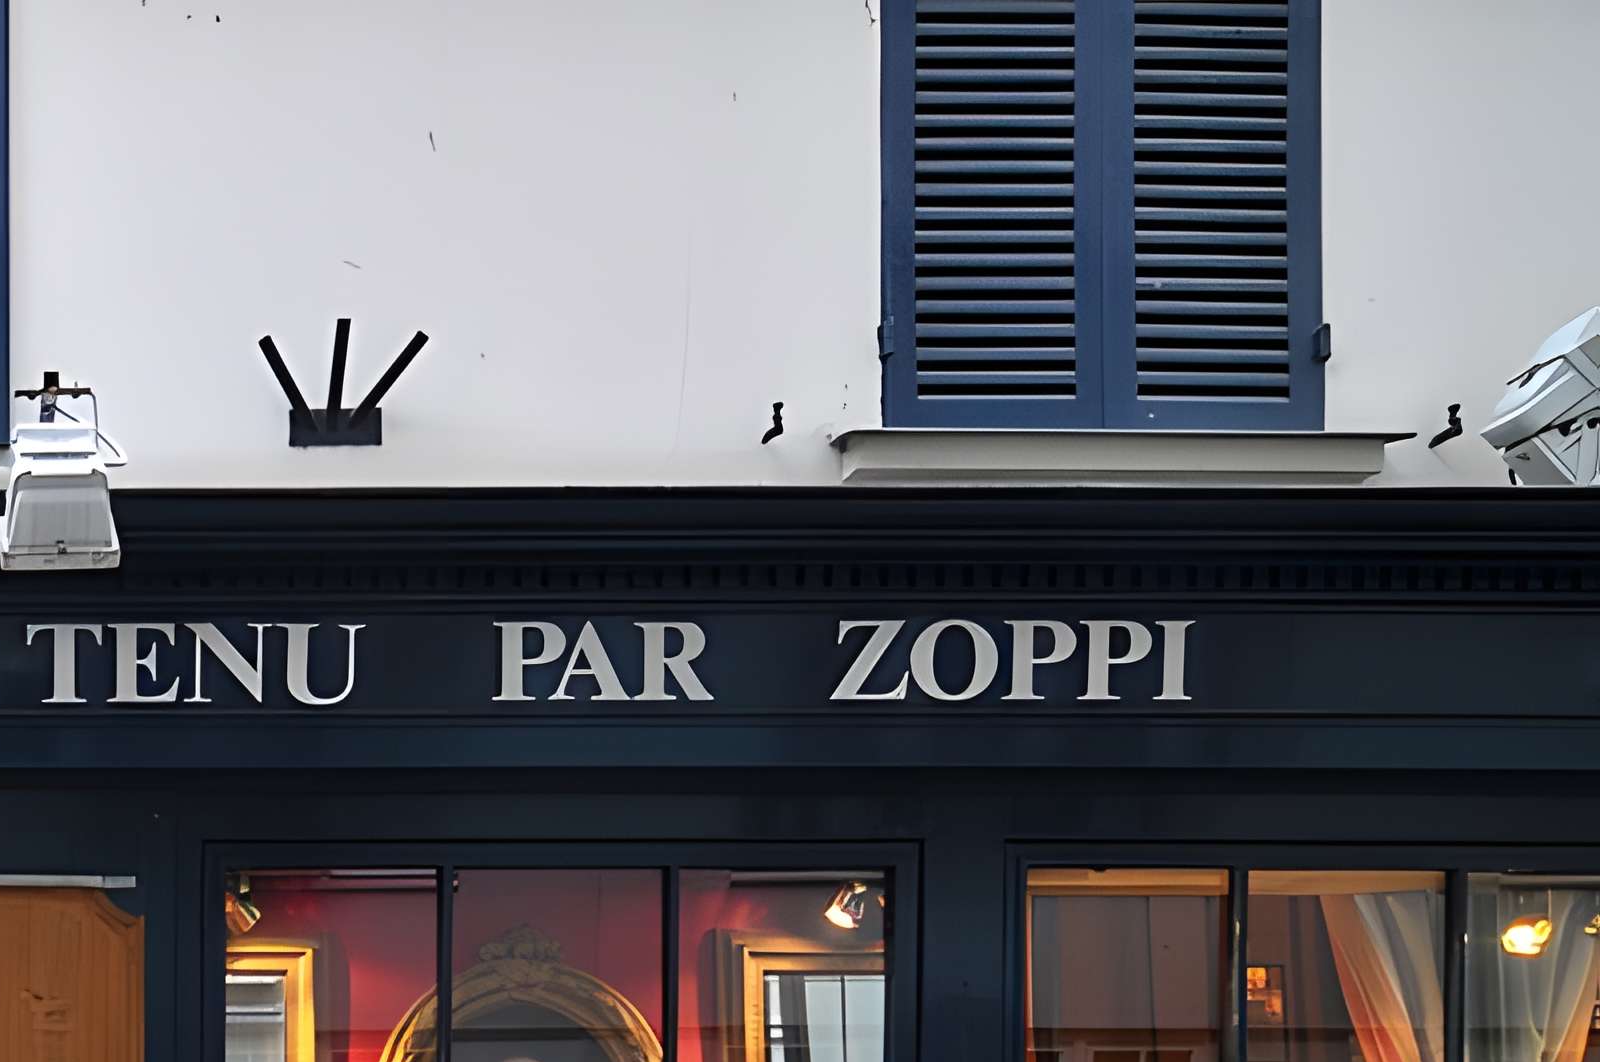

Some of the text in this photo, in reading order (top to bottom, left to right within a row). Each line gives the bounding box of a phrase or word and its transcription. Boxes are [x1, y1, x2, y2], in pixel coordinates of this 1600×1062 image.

[25, 621, 367, 705] TENU
[491, 620, 716, 702] PAR
[829, 618, 1197, 702] ZOPPI
